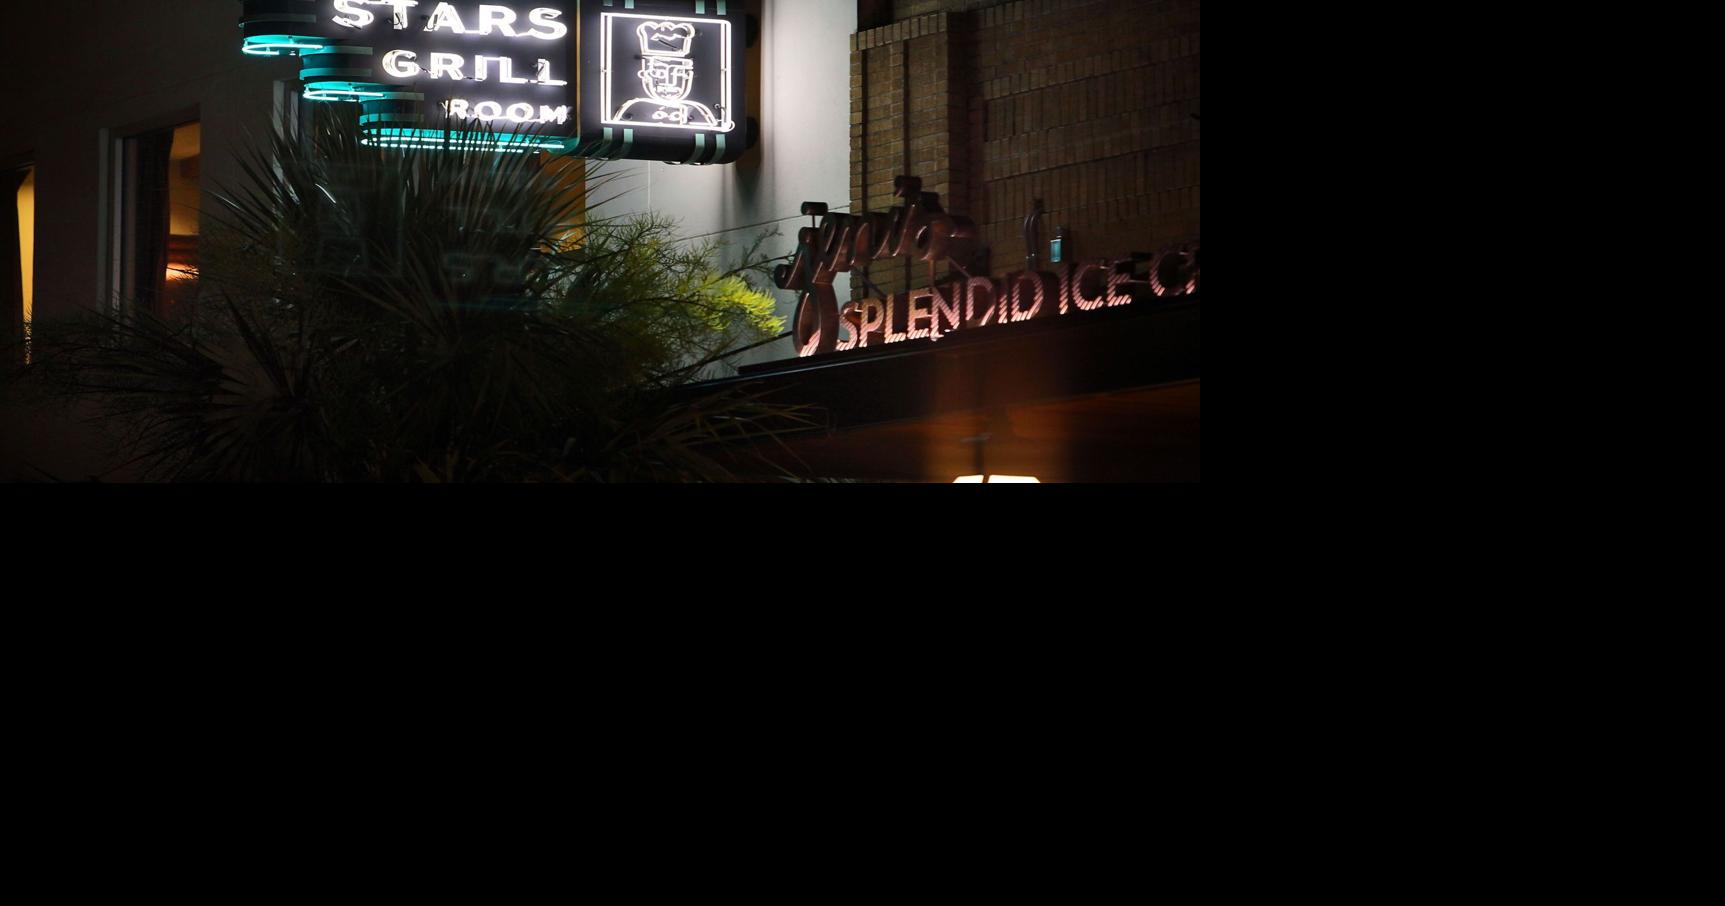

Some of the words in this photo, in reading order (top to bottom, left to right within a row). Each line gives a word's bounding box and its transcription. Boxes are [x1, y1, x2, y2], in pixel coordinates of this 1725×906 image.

[332, 0, 568, 40] STARS
[381, 49, 568, 86] GRILL
[443, 98, 569, 124] ROOM
[835, 268, 1045, 351] SPLENDID
[1060, 256, 1132, 316] ICE
